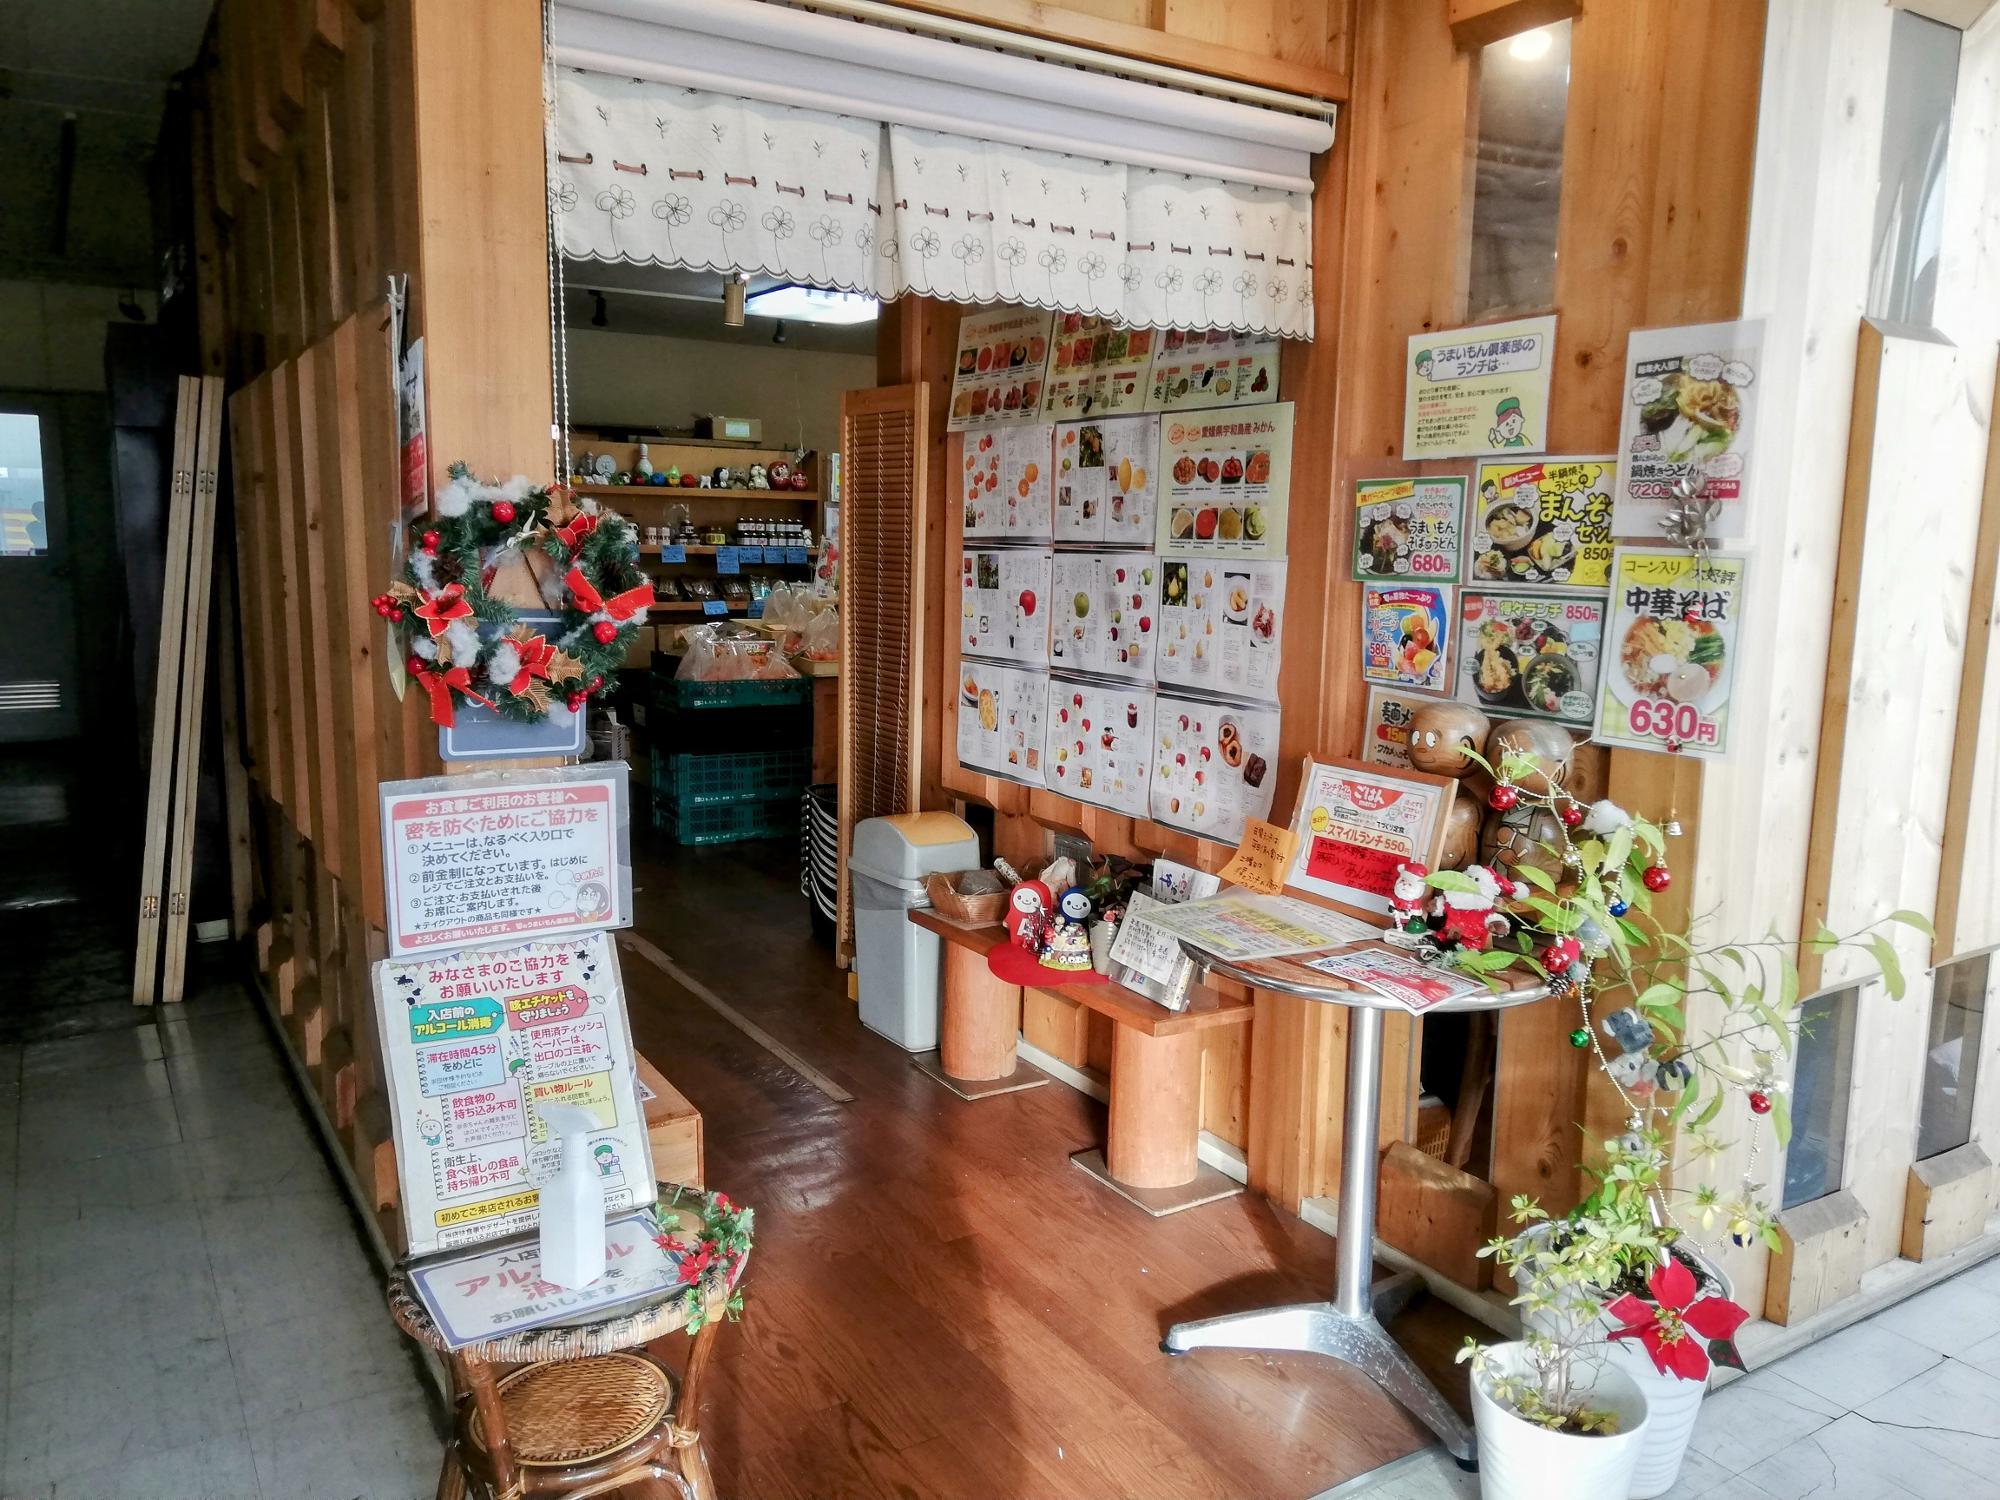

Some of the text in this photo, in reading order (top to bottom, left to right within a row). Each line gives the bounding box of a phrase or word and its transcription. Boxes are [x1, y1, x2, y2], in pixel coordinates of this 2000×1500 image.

[1437, 338, 1535, 363] うまいもん倶楽部の
[1540, 494, 1613, 522] まんぞ
[1410, 520, 1456, 535] うまいもん
[1412, 554, 1450, 573] 680円
[1625, 561, 1681, 574] コーン入り
[1500, 601, 1562, 618] 得々ランチ
[1566, 604, 1600, 622] 850円
[1626, 586, 1731, 620] 中華そば
[1630, 700, 1716, 743] 630円
[425, 792, 578, 816] お食事ご利用のお客様へ
[1354, 784, 1384, 804] ごはん
[404, 808, 599, 841] 密を防ぐためにご協力を
[422, 848, 511, 867] 決めてください。
[422, 870, 550, 894] レジでご注文とお支払いを。
[424, 898, 520, 918] お席にご案内します。
[415, 924, 511, 944] よろしくお願いいたします。
[428, 954, 569, 983] みなさまのご協力を
[440, 970, 564, 999] お願いいたします
[510, 990, 576, 1012] 咳エチケットを
[428, 1006, 475, 1022] 入店前の
[519, 1004, 570, 1022] 守りましょう
[414, 1016, 492, 1036] アルコール消毒
[530, 1020, 604, 1040] 使用済ティッシュ
[532, 1034, 586, 1049] ペーパーは、
[426, 1043, 497, 1064] 滞在時間45分
[534, 1042, 601, 1062] 出口のゴミ箱へ
[442, 1057, 483, 1072] をめどに
[534, 1078, 593, 1098] 買い物ルール
[452, 1092, 496, 1109] 飲食物の
[454, 1100, 517, 1120] 持ち込み不可
[446, 1156, 520, 1182] 食べ残しの食品
[446, 1170, 510, 1192] 持ち帰り不可
[490, 1283, 618, 1324] お願いします
